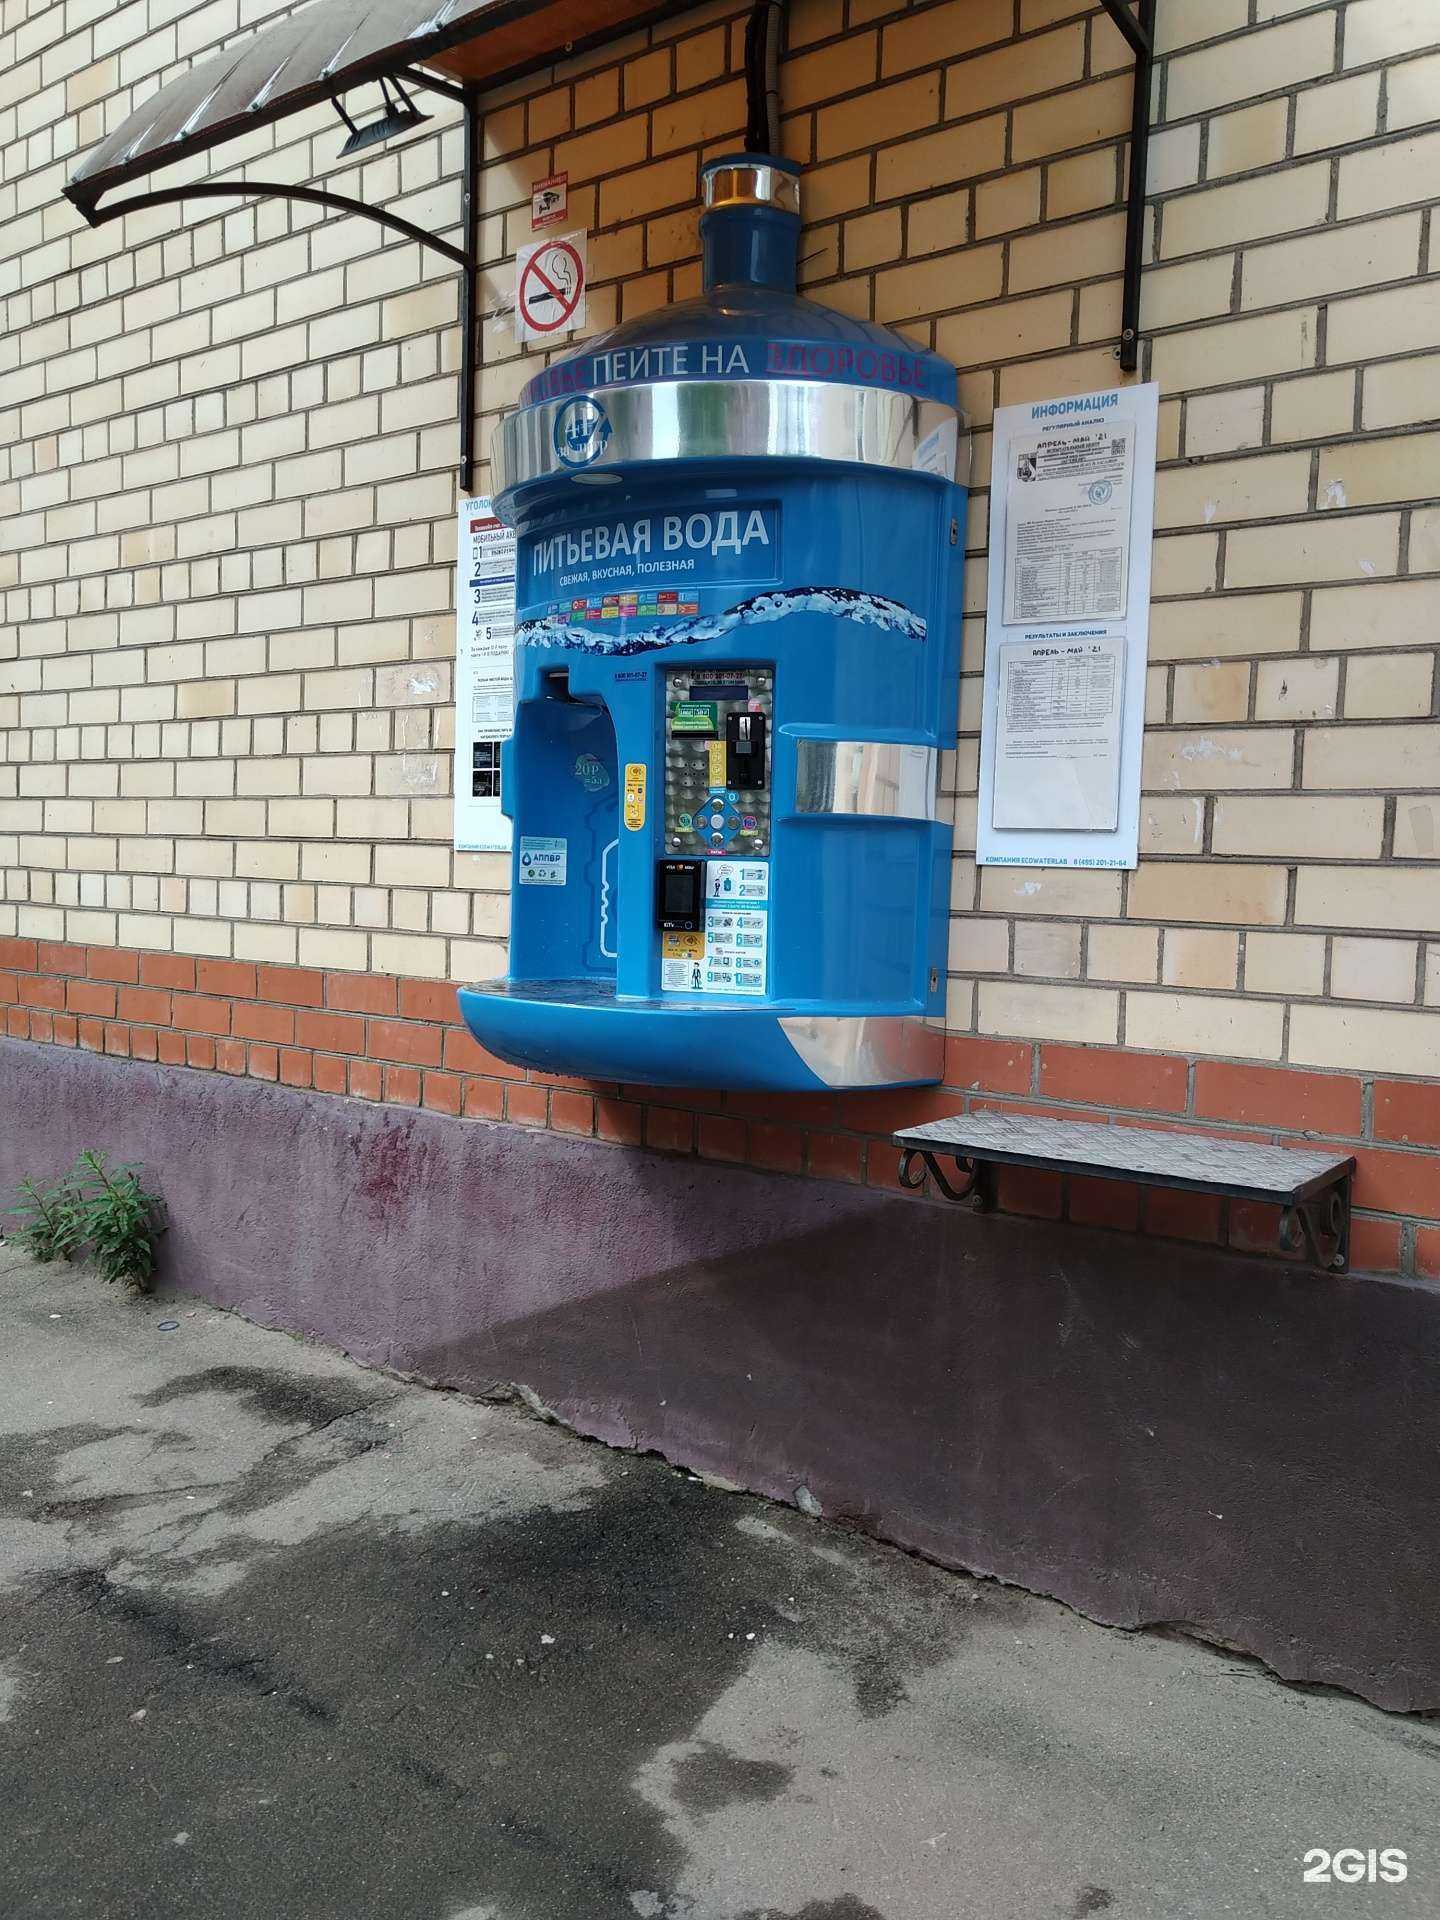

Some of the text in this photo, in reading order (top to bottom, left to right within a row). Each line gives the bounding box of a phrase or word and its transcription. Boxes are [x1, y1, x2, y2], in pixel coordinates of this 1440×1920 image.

[593, 343, 929, 388] ПЕЙТЕ НА ЗДОРОВЬЕ
[1031, 393, 1119, 420] ИНФОРМАЦИЯ
[1042, 417, 1105, 432] РЕГУЛЯРНЫЙ АНАЛИЗ
[465, 498, 493, 511] УГОЛО
[533, 510, 770, 576] ПИТЬЕВАЯ ВОДА
[474, 562, 481, 577] 2
[559, 558, 695, 587] СВЕЖАЯ, ВКУСНАЯ, ПОЛЕЗНАЯ
[474, 589, 480, 604] 3
[472, 611, 479, 626] 4
[486, 627, 492, 640] 5
[1025, 632, 1061, 640] РЕЗУЛЬТАТЫ
[1067, 629, 1107, 638] ЗАКЛЮЧЕНИЯ
[739, 868, 744, 880] 1
[739, 884, 746, 896] 2
[707, 916, 743, 928] 3 4
[707, 932, 743, 945] 5 6
[707, 956, 742, 968] 7 8
[707, 972, 742, 984] 9 10
